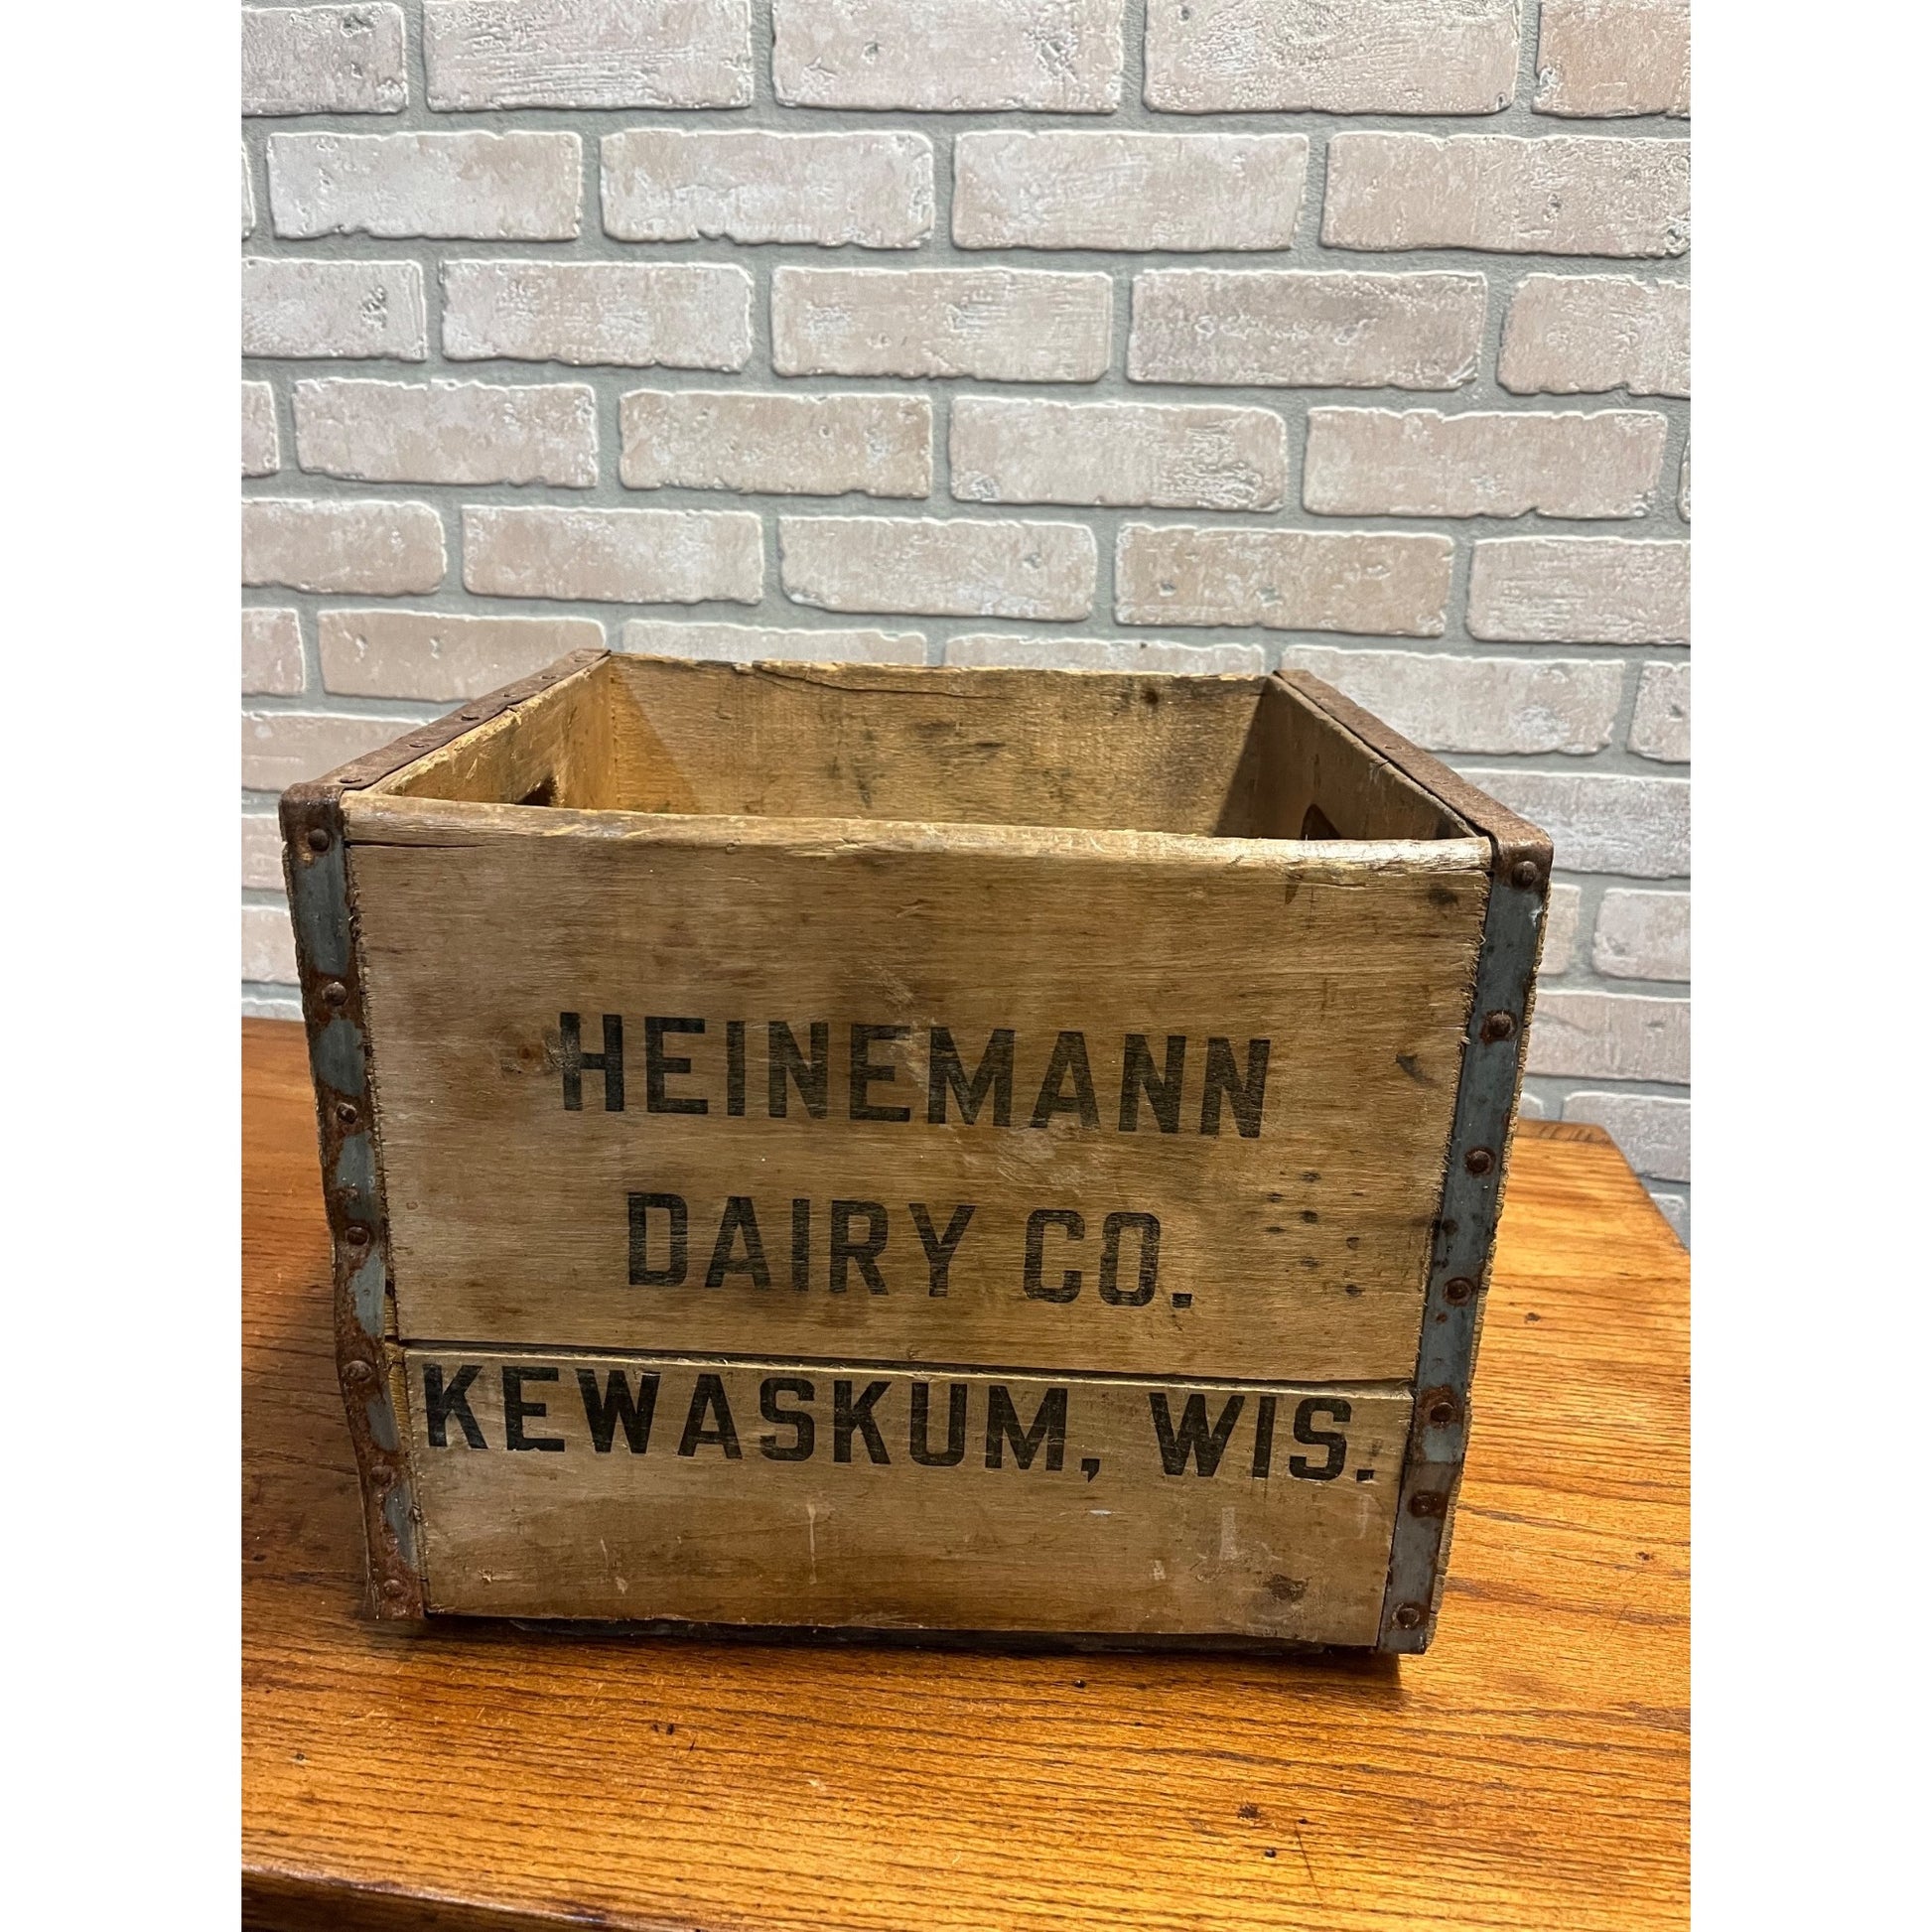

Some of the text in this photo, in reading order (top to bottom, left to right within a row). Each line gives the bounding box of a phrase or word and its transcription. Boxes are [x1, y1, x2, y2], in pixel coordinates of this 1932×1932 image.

[559, 1012, 1272, 1139] HEINEMANN
[627, 1192, 1193, 1309] DAIRY CO.
[423, 1364, 1375, 1483] KEWASKUM, WIS.
